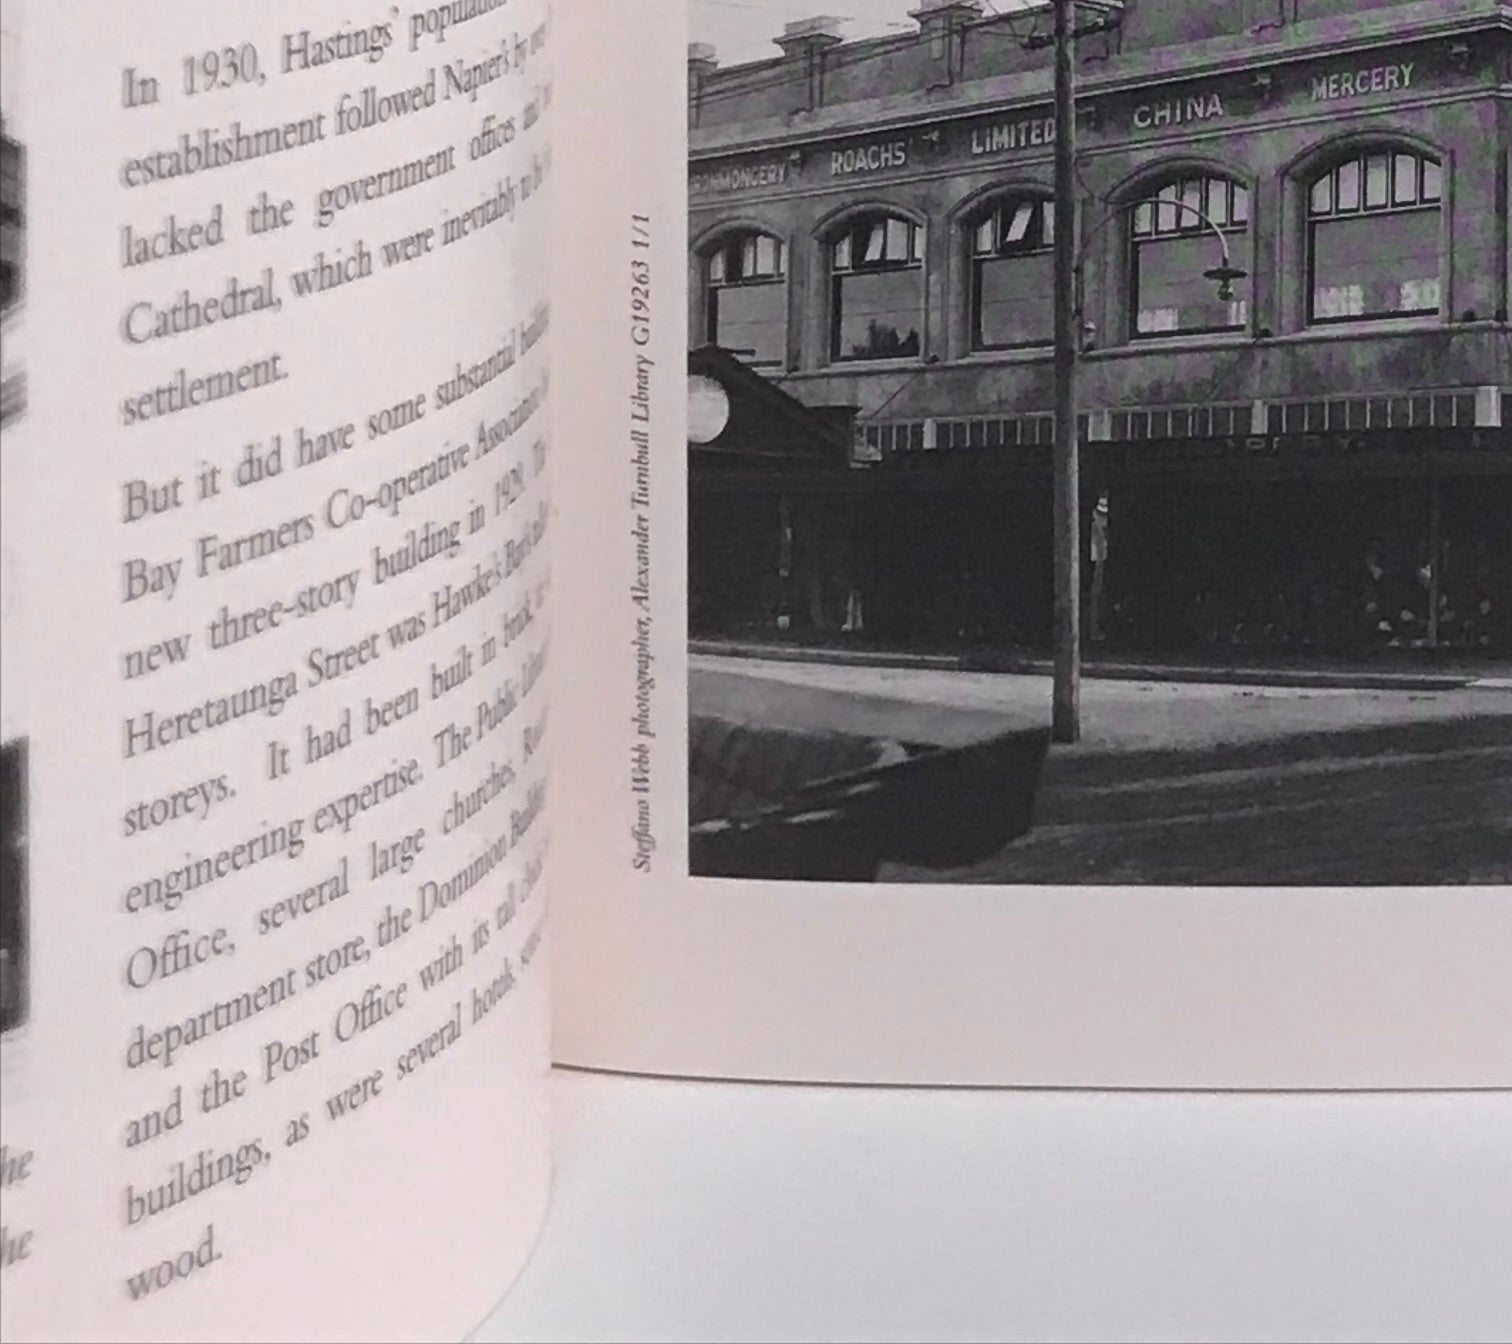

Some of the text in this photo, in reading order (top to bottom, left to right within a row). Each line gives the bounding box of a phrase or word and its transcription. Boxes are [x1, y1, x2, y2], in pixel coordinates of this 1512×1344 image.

[121, 110, 326, 189] establishment
[334, 69, 437, 137] followed
[122, 67, 159, 109] In
[180, 43, 266, 96] 1930,
[971, 118, 1055, 155] LIMITED
[1133, 93, 1224, 129] CHINA
[1312, 63, 1415, 102] MERCERY
[121, 204, 223, 268] lacked
[246, 191, 294, 237] the
[315, 144, 456, 228] government
[121, 224, 435, 347] Cathedral, which were
[120, 353, 288, 426] settlement.
[122, 479, 183, 526] But
[199, 459, 220, 499] it
[233, 435, 283, 488] did
[295, 422, 354, 469] have
[367, 390, 427, 439] some
[122, 557, 183, 604] Bay
[196, 510, 314, 579] Farmers
[326, 439, 469, 528] Co-operative
[630, 214, 657, 874] Steffano Webb photographer, Alexander Turnbull Library G19263 1/1
[123, 632, 192, 680] new
[209, 565, 361, 652] three-story
[373, 515, 462, 587] building
[122, 767, 237, 838] storeys.
[305, 718, 352, 765] had
[365, 685, 420, 735] been
[430, 649, 473, 700] built
[123, 611, 426, 760] Heretaunga Street was
[126, 819, 304, 915] engineering
[314, 758, 423, 835] expertise.
[434, 722, 471, 769] The
[126, 827, 425, 991] Office, several large
[127, 969, 298, 1069] department
[305, 936, 370, 987] store,
[377, 907, 412, 950] the
[418, 834, 508, 924] Dominion
[126, 1086, 183, 1149] and
[201, 1068, 247, 1115] the
[263, 1030, 320, 1086] Post
[334, 980, 407, 1043] Office
[420, 935, 463, 991] with
[0, 1144, 34, 1187] he
[126, 1004, 462, 1226] buildings, as were several
[0, 1225, 34, 1266] he
[127, 1224, 223, 1302] wood.
